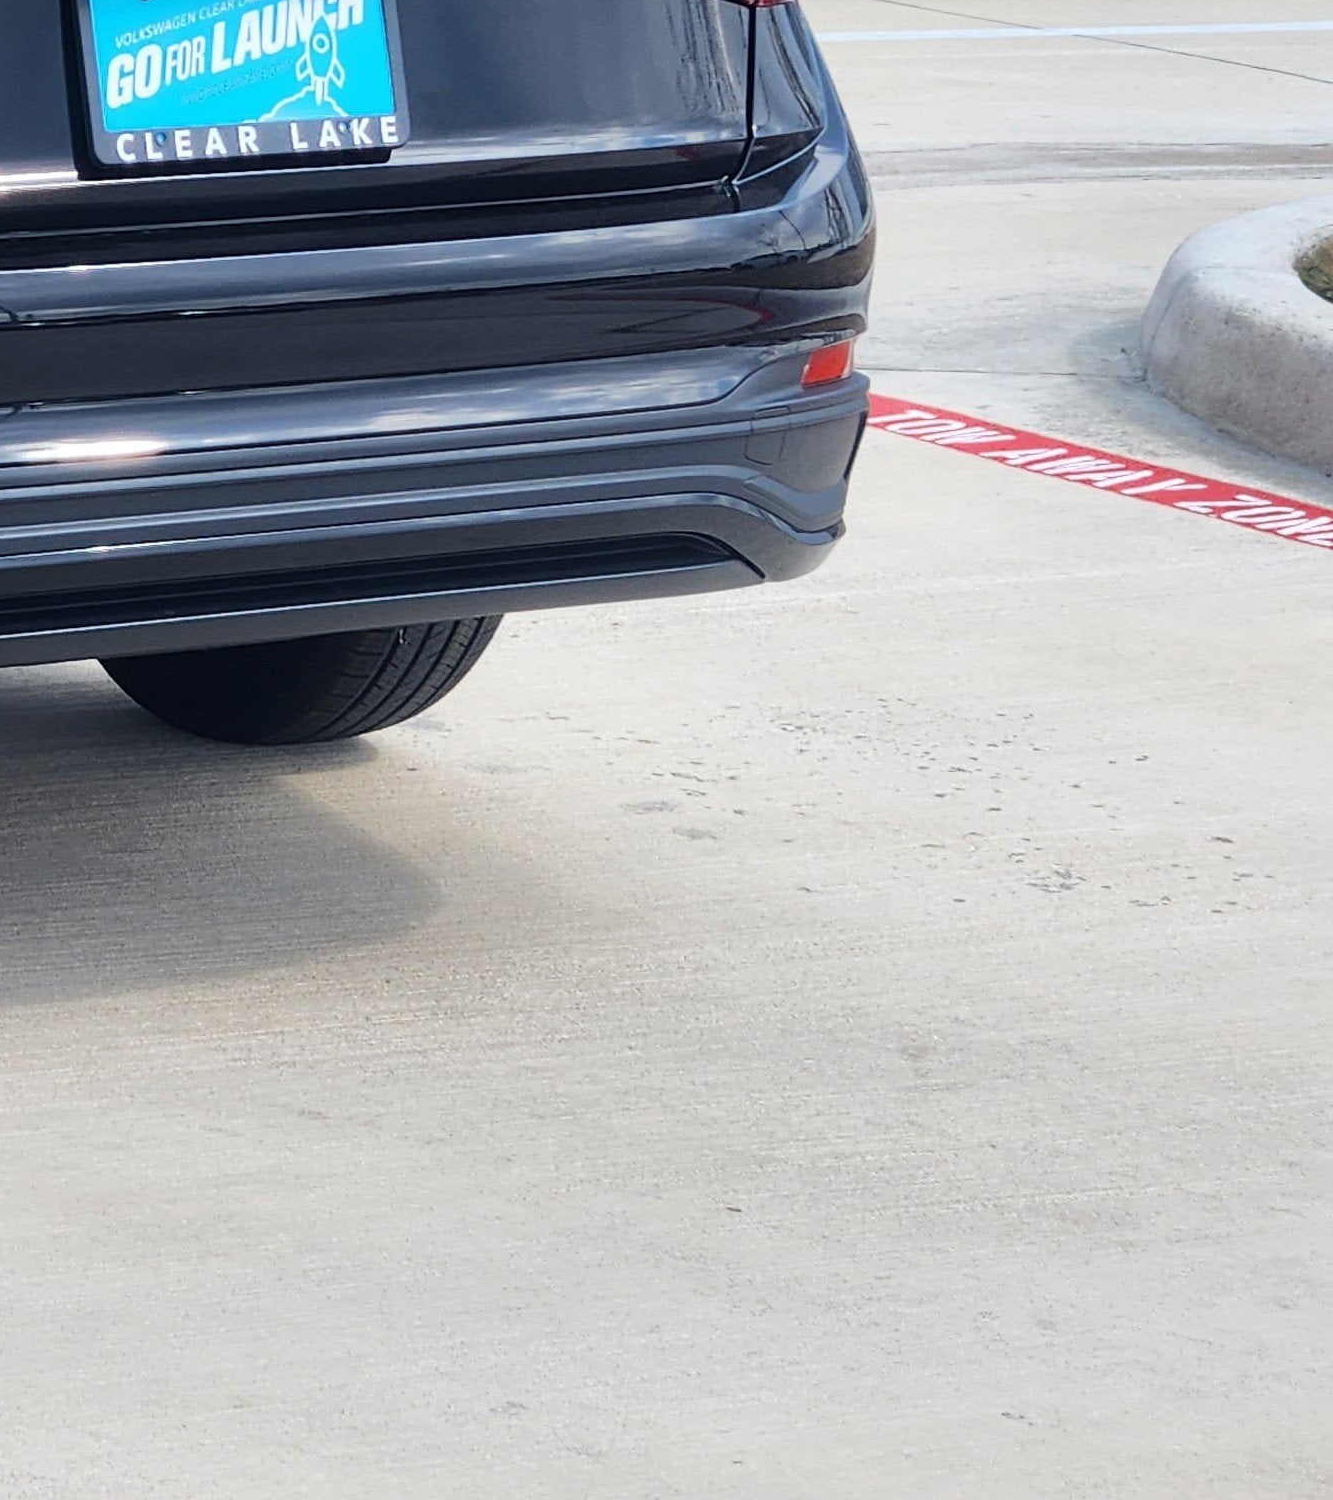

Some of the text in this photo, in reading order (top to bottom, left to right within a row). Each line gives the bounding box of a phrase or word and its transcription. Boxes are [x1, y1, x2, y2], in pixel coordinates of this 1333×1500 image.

[114, 11, 197, 49] VOLKSWAGEN
[105, 43, 164, 110] GO
[165, 34, 207, 86] FOR
[116, 115, 400, 163] CLEAR LAKE
[867, 409, 1018, 446] TOW
[978, 447, 1208, 496] AWAY
